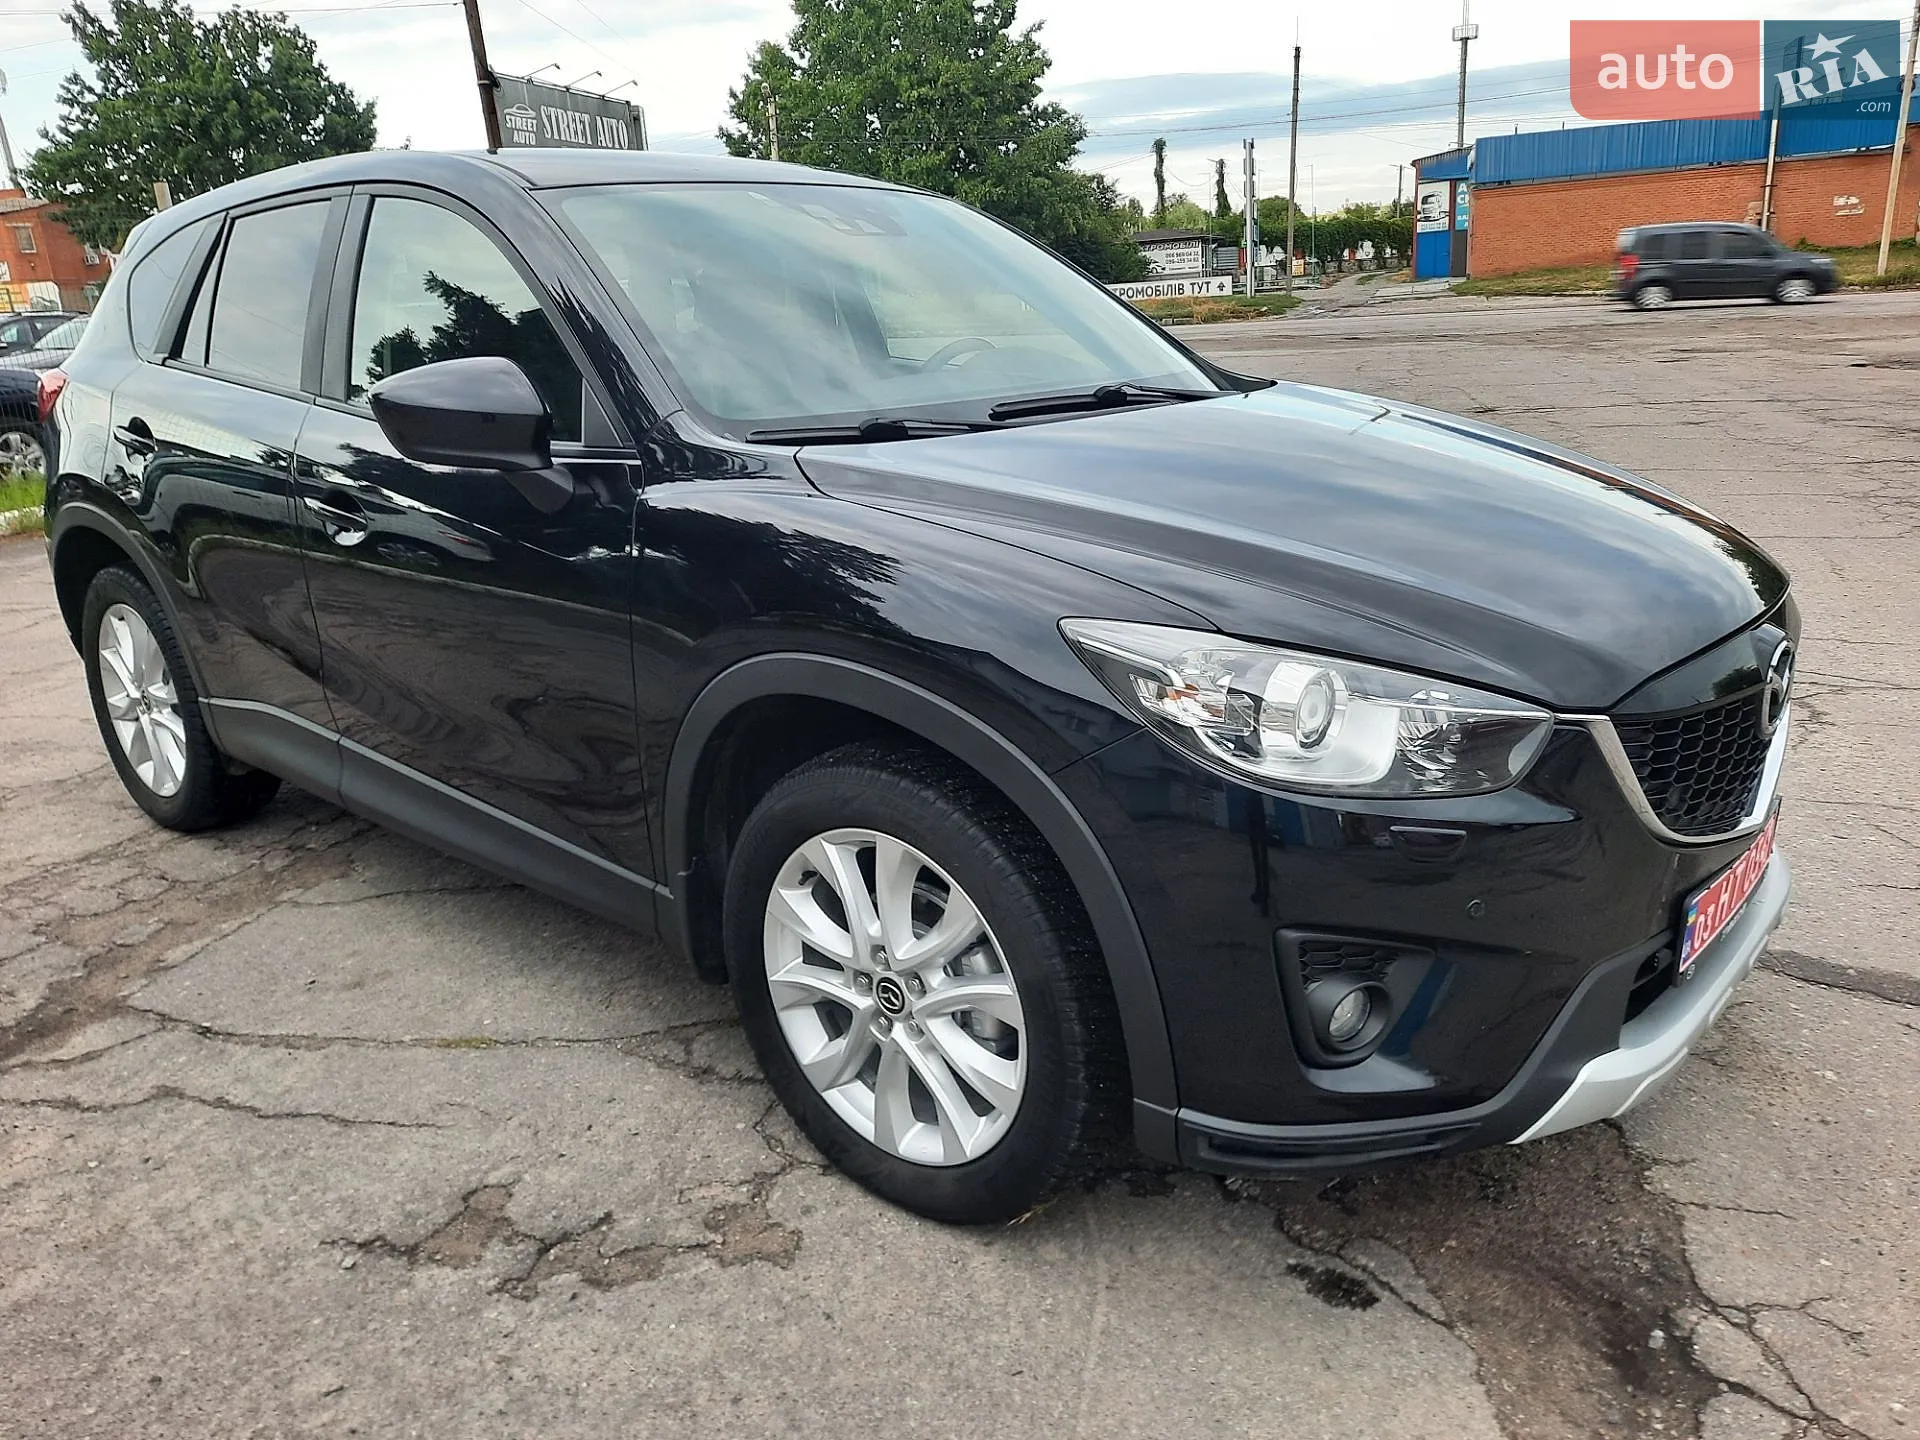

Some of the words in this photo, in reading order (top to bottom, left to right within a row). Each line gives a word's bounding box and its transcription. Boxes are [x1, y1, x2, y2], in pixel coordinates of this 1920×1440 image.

[505, 114, 537, 132] STREET
[540, 104, 592, 146] STREET
[595, 116, 629, 150] AUTO
[513, 129, 536, 146] AUTO
[1141, 240, 1199, 251] ТРОМОБІЛІ
[1190, 281, 1211, 295] ТУТ
